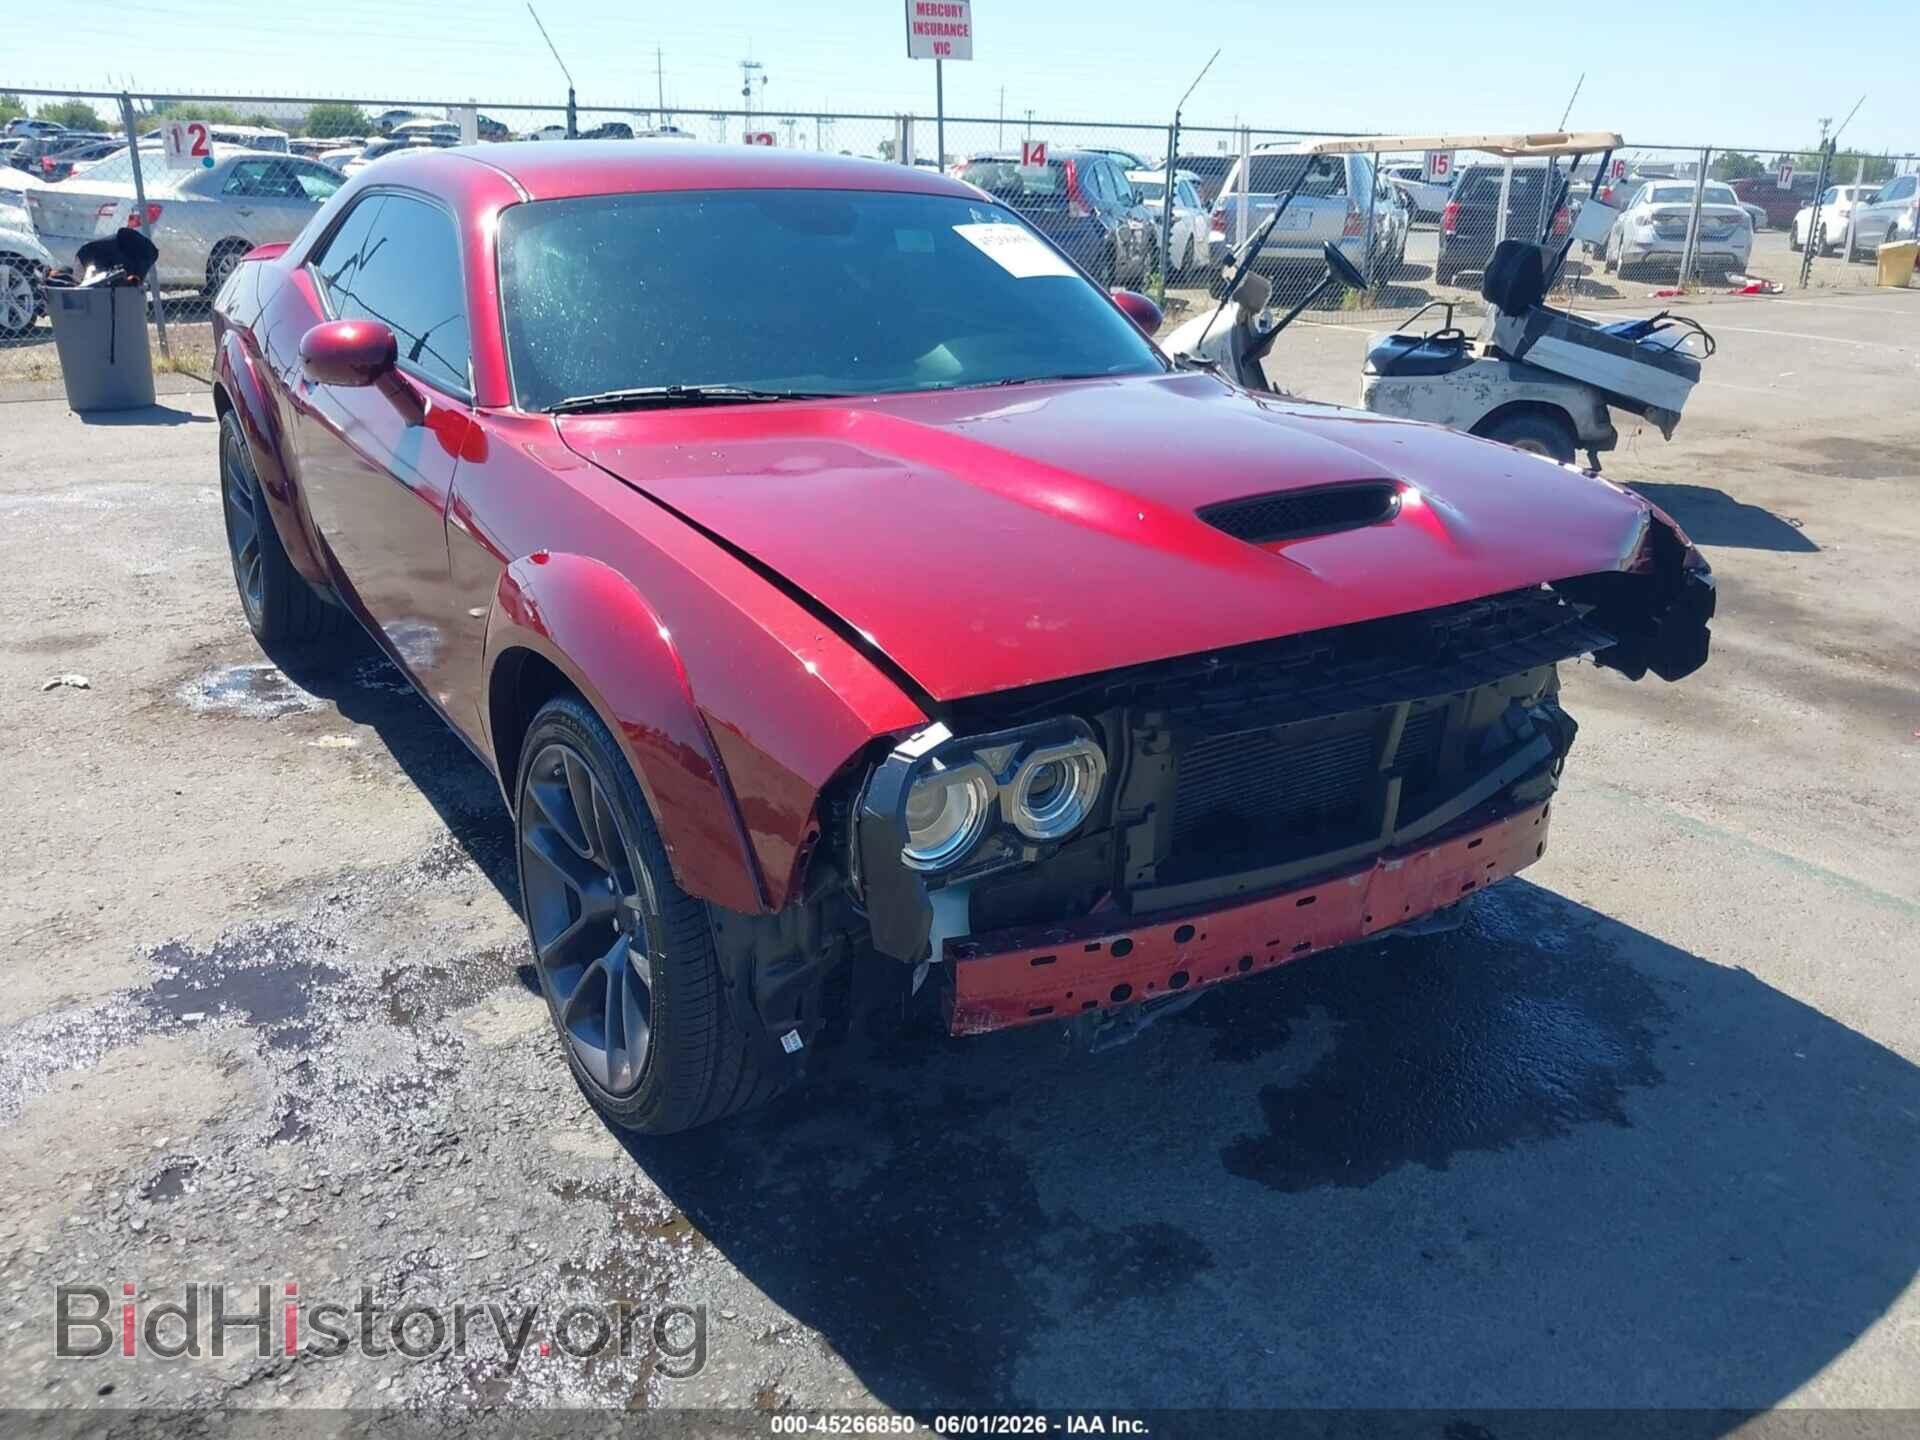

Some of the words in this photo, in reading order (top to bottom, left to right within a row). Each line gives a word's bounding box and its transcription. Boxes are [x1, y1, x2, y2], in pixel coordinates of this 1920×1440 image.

[916, 2, 963, 17] MERCURY
[913, 21, 969, 37] INSURANCE
[933, 41, 951, 55] VIC
[1023, 143, 1046, 167] 14
[1432, 154, 1449, 175] 15
[1611, 160, 1625, 178] 16
[1780, 166, 1793, 182] 17
